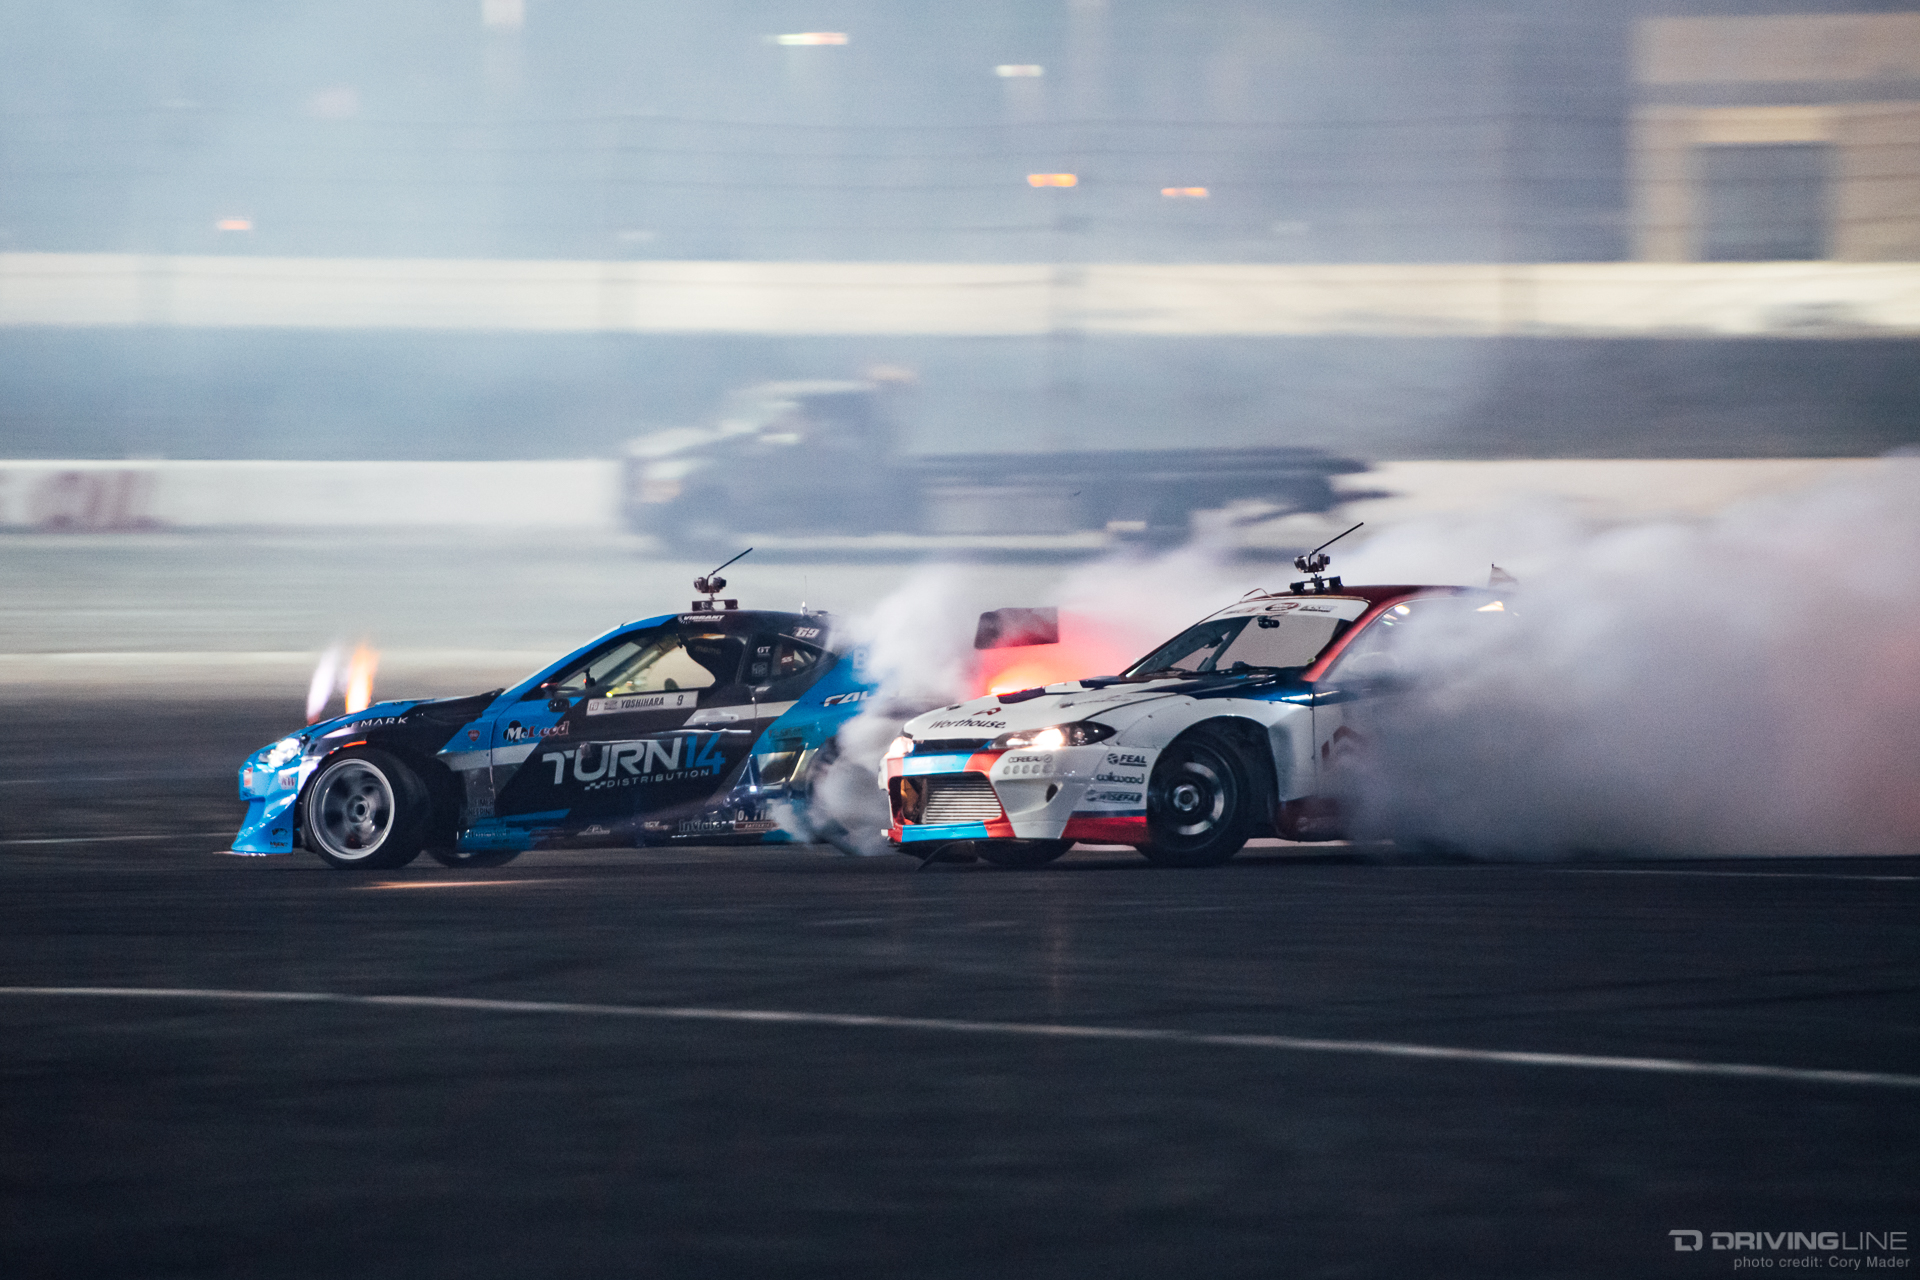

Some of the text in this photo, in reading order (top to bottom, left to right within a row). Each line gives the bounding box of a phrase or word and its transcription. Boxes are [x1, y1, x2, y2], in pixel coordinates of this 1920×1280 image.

[795, 627, 820, 638] 69
[621, 697, 665, 709] YOSHIHARA
[676, 695, 684, 706] 9
[1119, 755, 1147, 764] FEAL
[607, 769, 709, 788] DISTRIBUTION
[1096, 772, 1145, 784] wilwood
